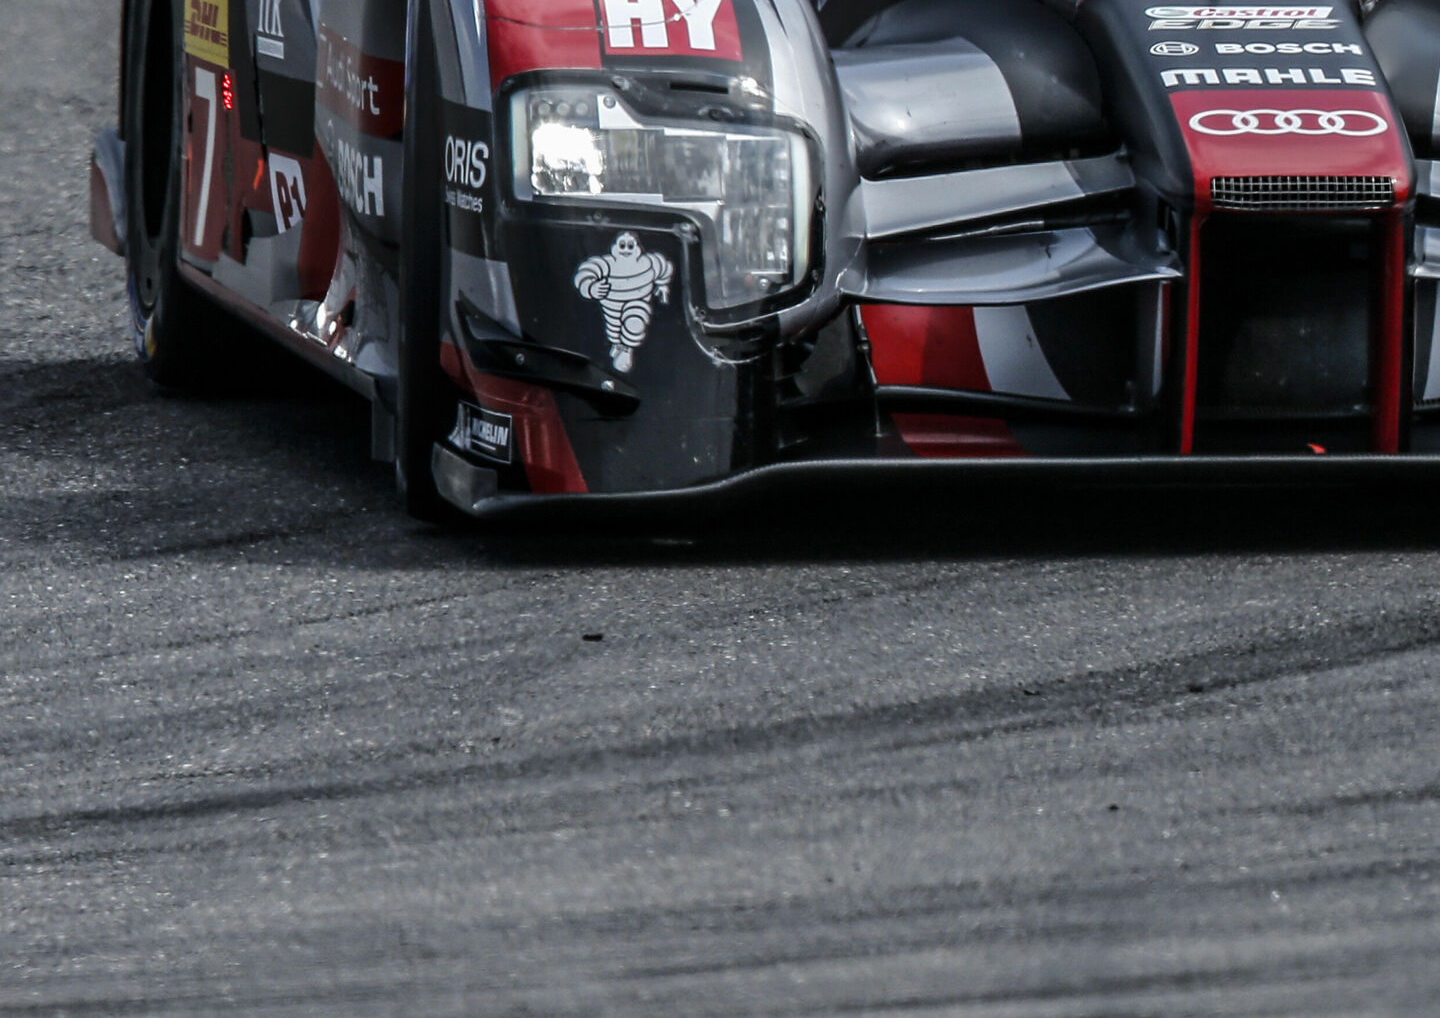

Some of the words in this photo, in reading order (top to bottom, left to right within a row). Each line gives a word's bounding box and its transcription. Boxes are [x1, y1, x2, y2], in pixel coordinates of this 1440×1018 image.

[1192, 8, 1318, 18] Castrol
[1148, 19, 1345, 31] EDGE
[1215, 43, 1364, 55] BOSCH
[1160, 68, 1377, 88] MAHLE
[193, 66, 217, 248] 7
[444, 134, 489, 189] ORIS
[274, 170, 308, 231] P1
